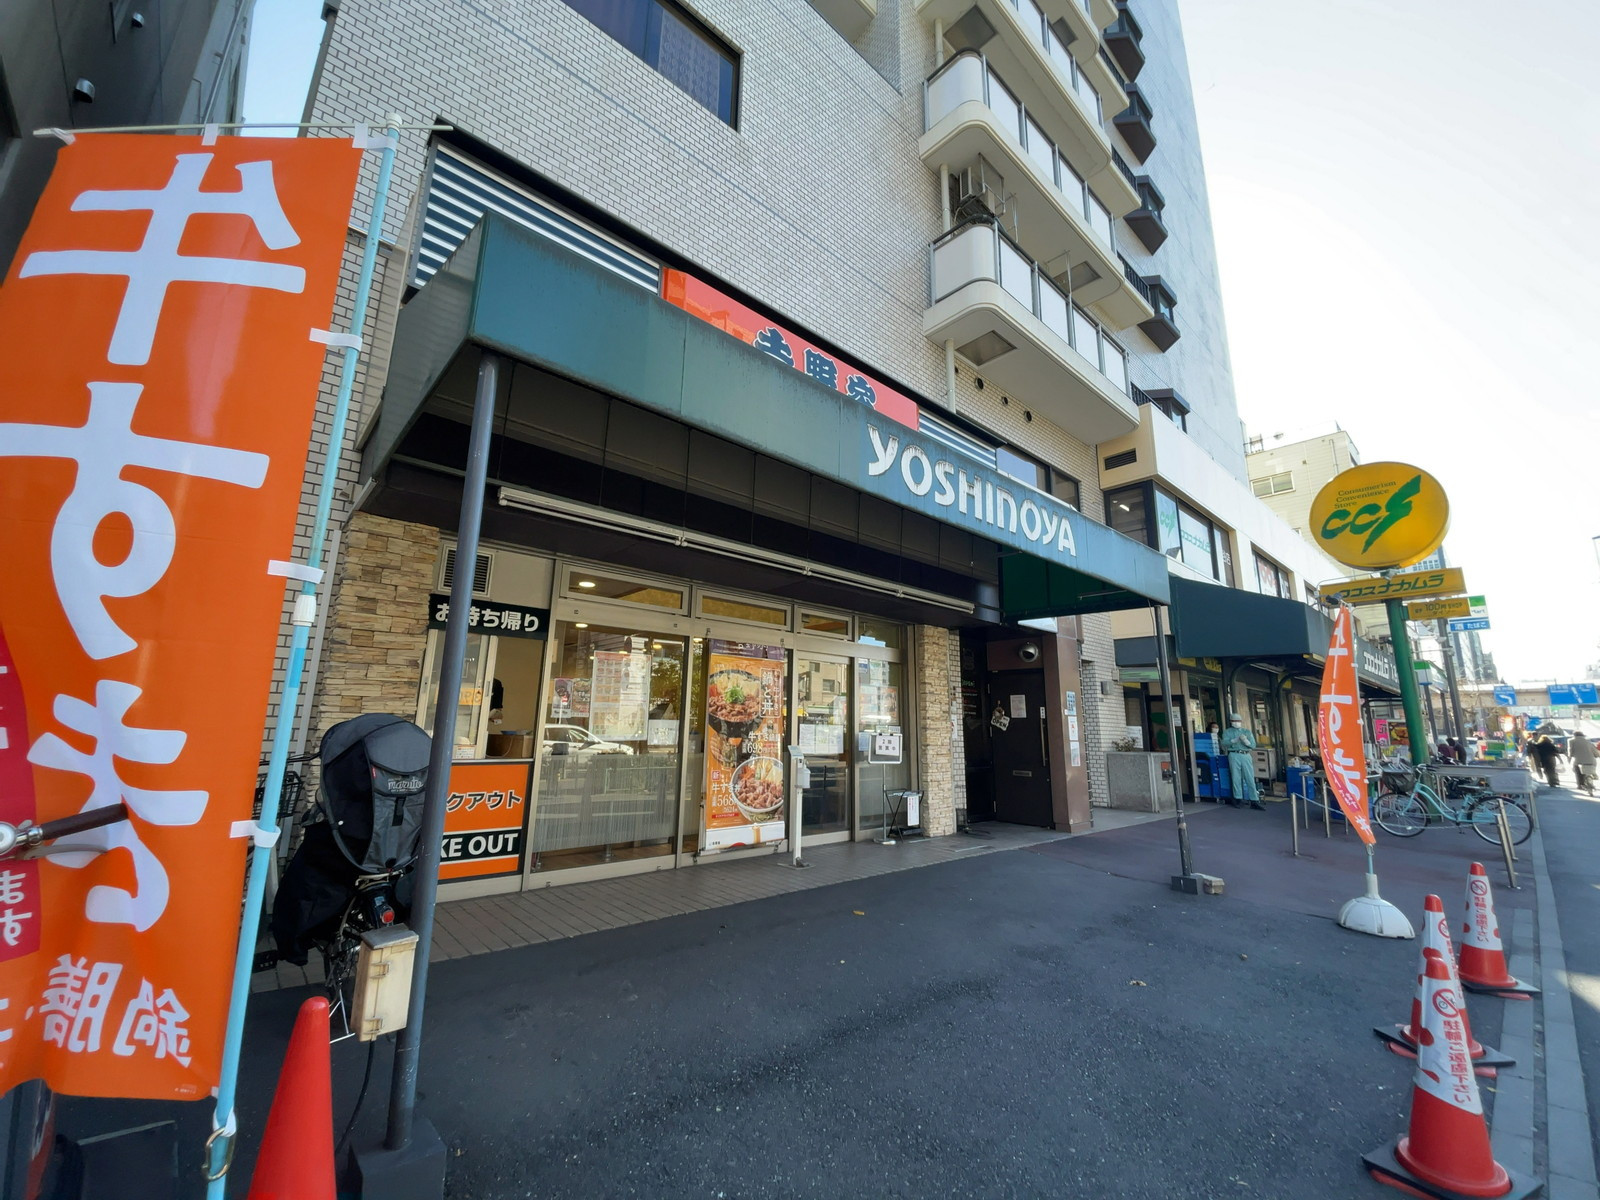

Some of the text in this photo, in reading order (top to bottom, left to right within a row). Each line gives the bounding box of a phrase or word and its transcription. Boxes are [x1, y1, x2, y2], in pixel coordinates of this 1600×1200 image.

[1336, 488, 1390, 502] Convenience
[1338, 481, 1397, 496] Consumerism
[1334, 500, 1358, 510] Store
[992, 718, 1007, 729] OPEN
[446, 789, 522, 812] クアウト
[440, 833, 519, 858] KE OUT
